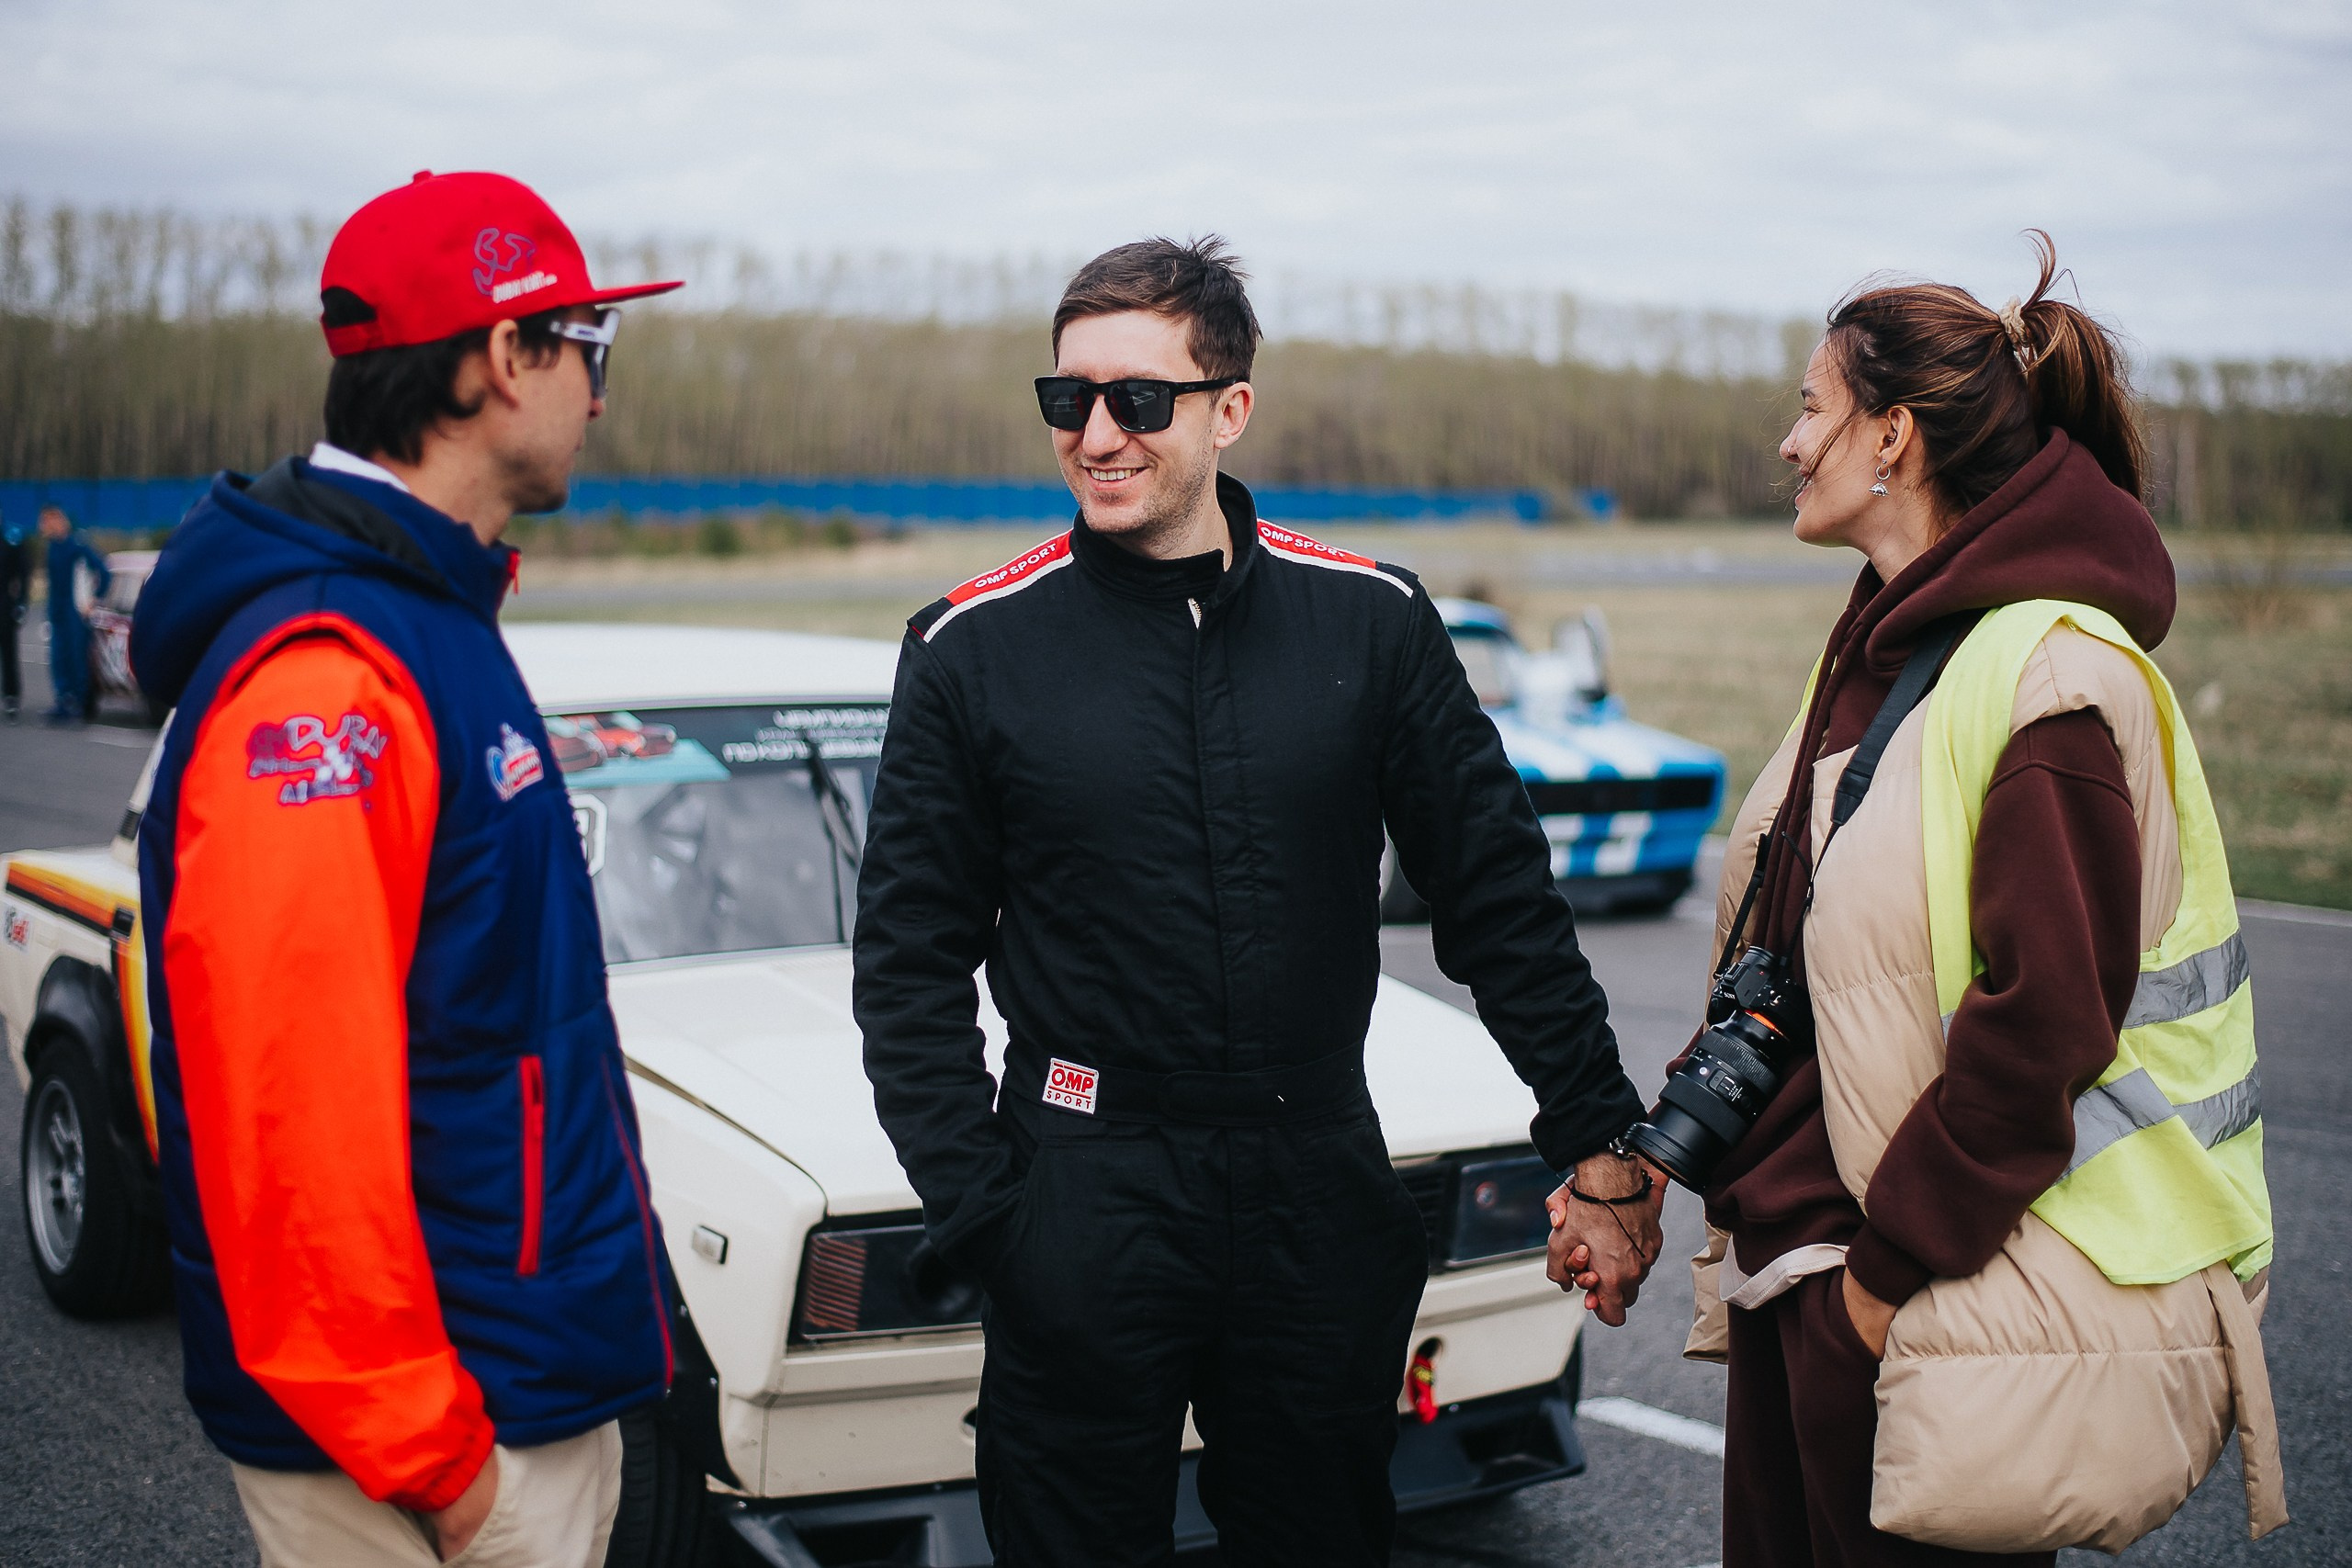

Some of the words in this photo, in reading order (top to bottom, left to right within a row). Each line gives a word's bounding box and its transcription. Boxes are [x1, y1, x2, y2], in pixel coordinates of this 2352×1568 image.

[1260, 526, 1294, 544] OMP
[1294, 538, 1346, 558] SPORT
[974, 570, 1008, 589] OMP
[1010, 543, 1057, 575] SPORT
[1051, 1067, 1094, 1093] OMP
[1046, 1090, 1091, 1110] SPORT
